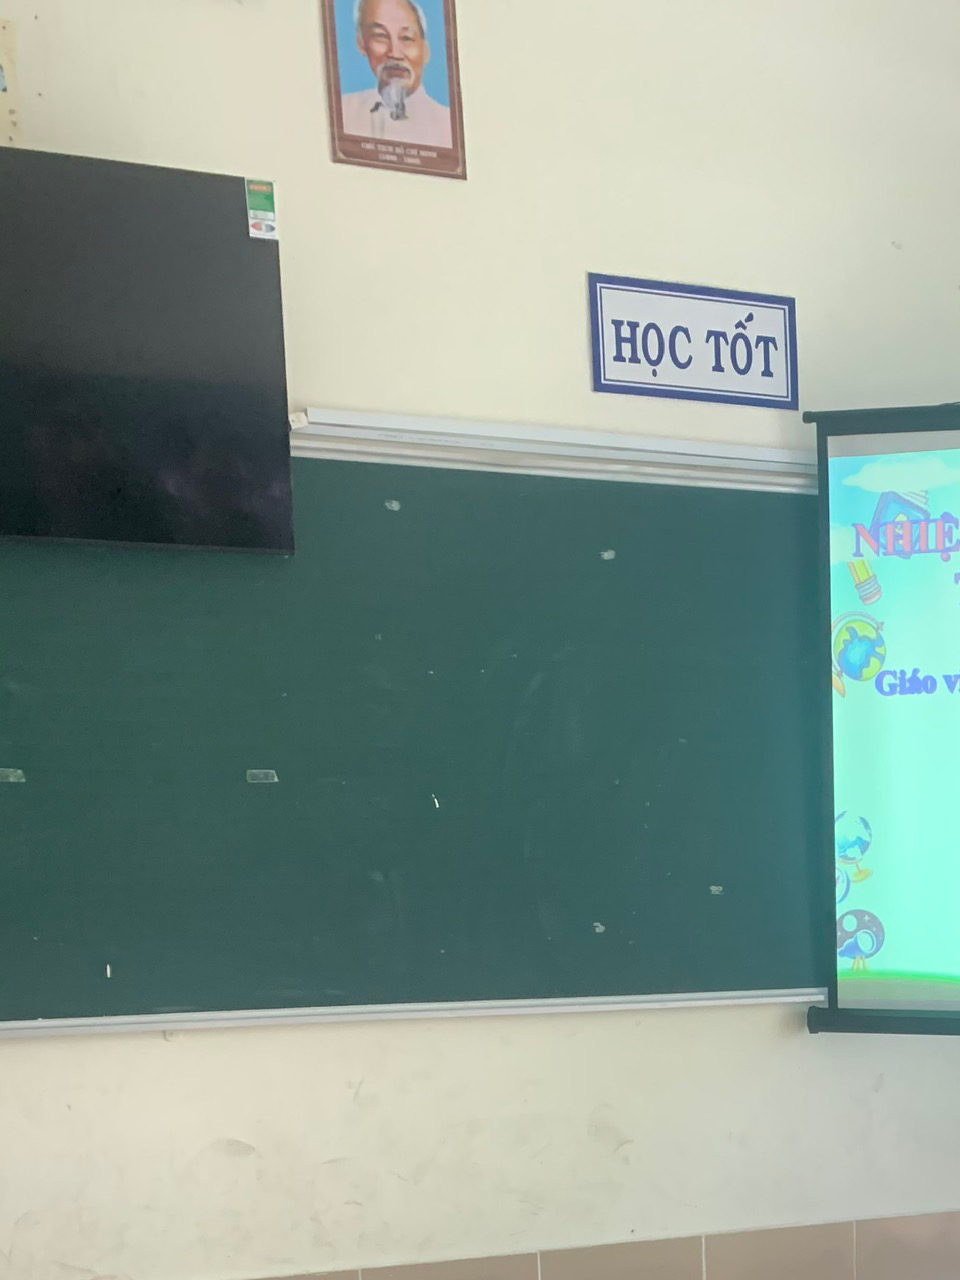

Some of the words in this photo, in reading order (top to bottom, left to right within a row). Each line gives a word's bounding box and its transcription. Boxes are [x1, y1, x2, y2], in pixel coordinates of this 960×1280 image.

[610, 318, 693, 378] HỌC
[705, 312, 778, 378] TỐT
[874, 667, 938, 696] Giáo
